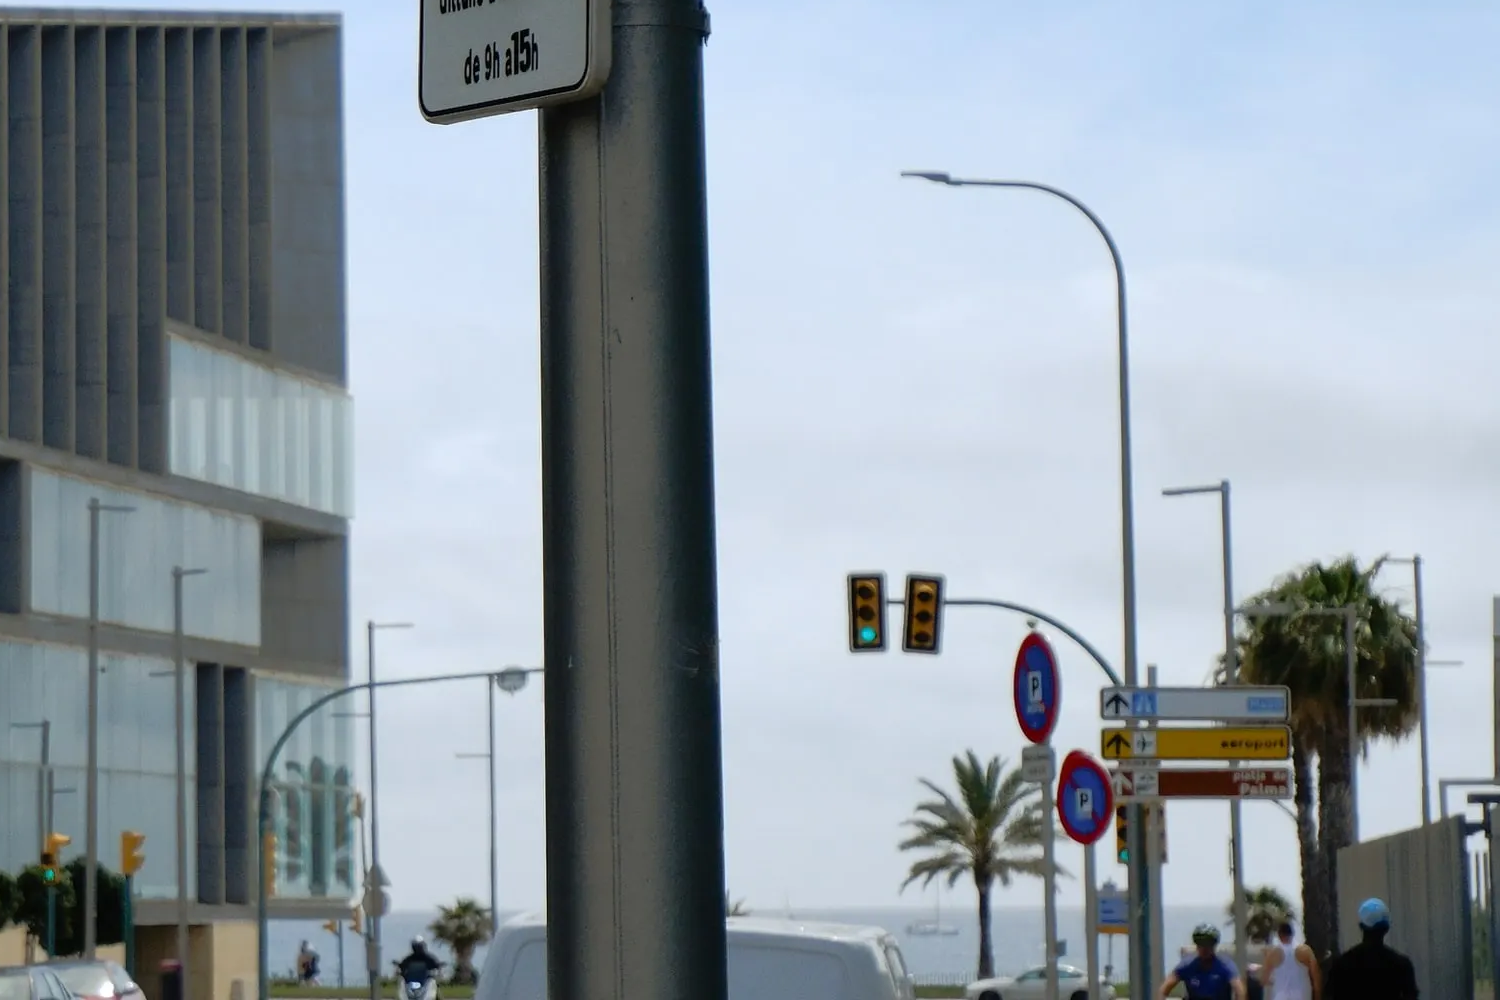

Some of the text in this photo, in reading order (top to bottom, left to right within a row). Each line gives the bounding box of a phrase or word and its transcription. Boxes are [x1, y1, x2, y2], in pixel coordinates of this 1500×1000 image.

[464, 48, 480, 85] de
[485, 42, 500, 80] 9h
[1220, 736, 1286, 752] aeroport
[1240, 782, 1286, 796] Palma
